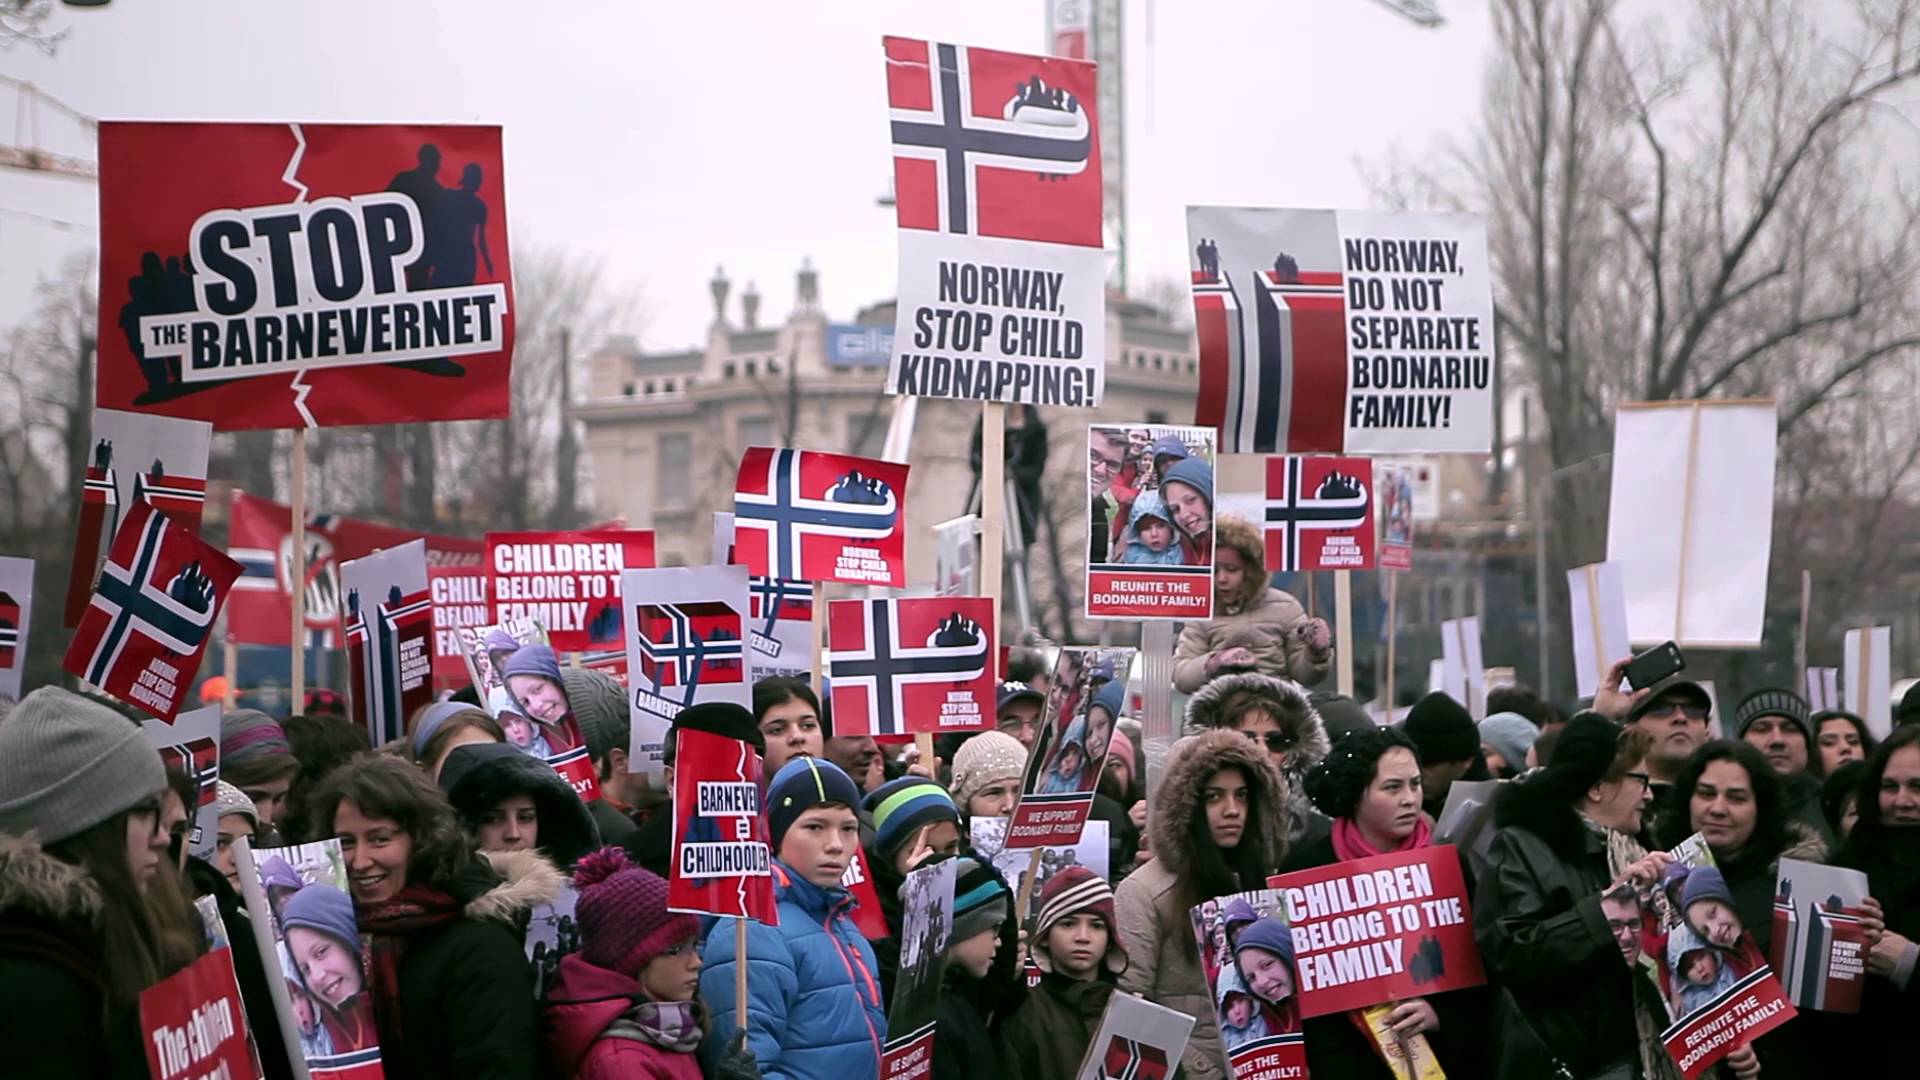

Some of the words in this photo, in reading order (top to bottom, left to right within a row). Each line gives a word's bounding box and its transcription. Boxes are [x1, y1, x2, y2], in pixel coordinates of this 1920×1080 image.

[199, 202, 412, 315] STOP
[1344, 239, 1463, 276] NORWAY,
[939, 261, 1064, 316] NORWAY,
[1348, 279, 1385, 310] DO
[1392, 280, 1443, 311] NOT
[150, 324, 187, 346] THE
[191, 295, 496, 370] BARNEVERNET
[914, 307, 993, 352] STOP
[1000, 314, 1083, 360] CHILD
[1350, 317, 1479, 350] SEPARATE
[897, 354, 1095, 407] KIDNAPPING!
[1352, 356, 1489, 389] BODNARIU
[1350, 395, 1451, 428] FAMILY!
[495, 544, 623, 573] CHILDREN
[431, 576, 487, 604] CHIL
[495, 575, 575, 600] BELONG
[579, 576, 607, 598] TO
[1092, 594, 1158, 606] BODNARIU
[1161, 596, 1207, 608] FAMILY!
[1111, 581, 1164, 593] REUNITE
[1166, 584, 1191, 594] THE
[1290, 864, 1434, 923] CHILDREN
[1290, 912, 1387, 955] BELONG
[1388, 904, 1421, 939] TO
[1421, 898, 1465, 933] THE
[1299, 938, 1405, 993] FAMILY
[1679, 1027, 1736, 1072] BODNARIU
[1734, 998, 1785, 1034] FAMILY!
[1684, 1011, 1735, 1049] REUNITE
[1733, 995, 1760, 1017] THE
[153, 1025, 190, 1079] The
[1254, 1053, 1280, 1069] THE
